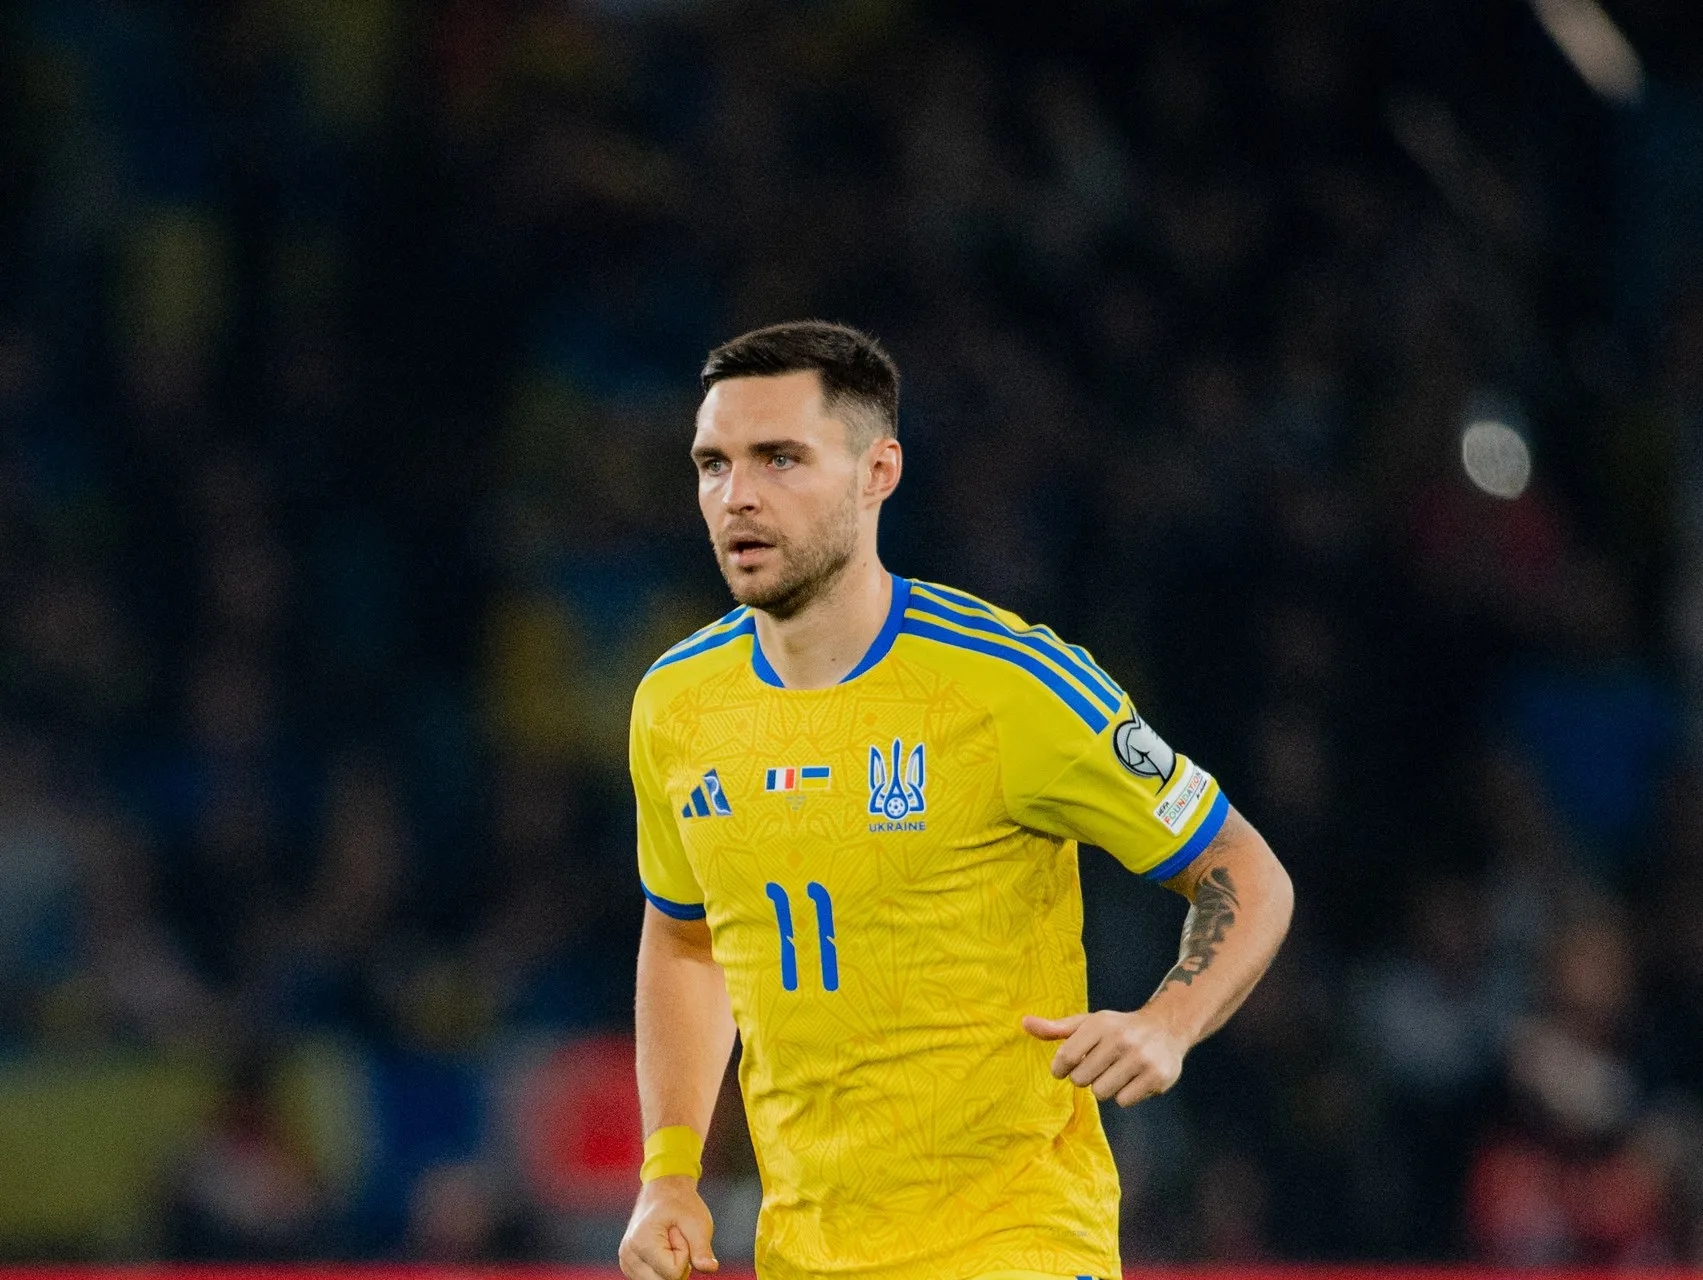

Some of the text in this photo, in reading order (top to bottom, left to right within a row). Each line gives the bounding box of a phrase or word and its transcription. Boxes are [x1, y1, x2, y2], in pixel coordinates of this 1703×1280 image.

[1164, 772, 1201, 824] FOUNDATION
[868, 821, 927, 833] UKRAINE
[765, 881, 840, 992] 11
